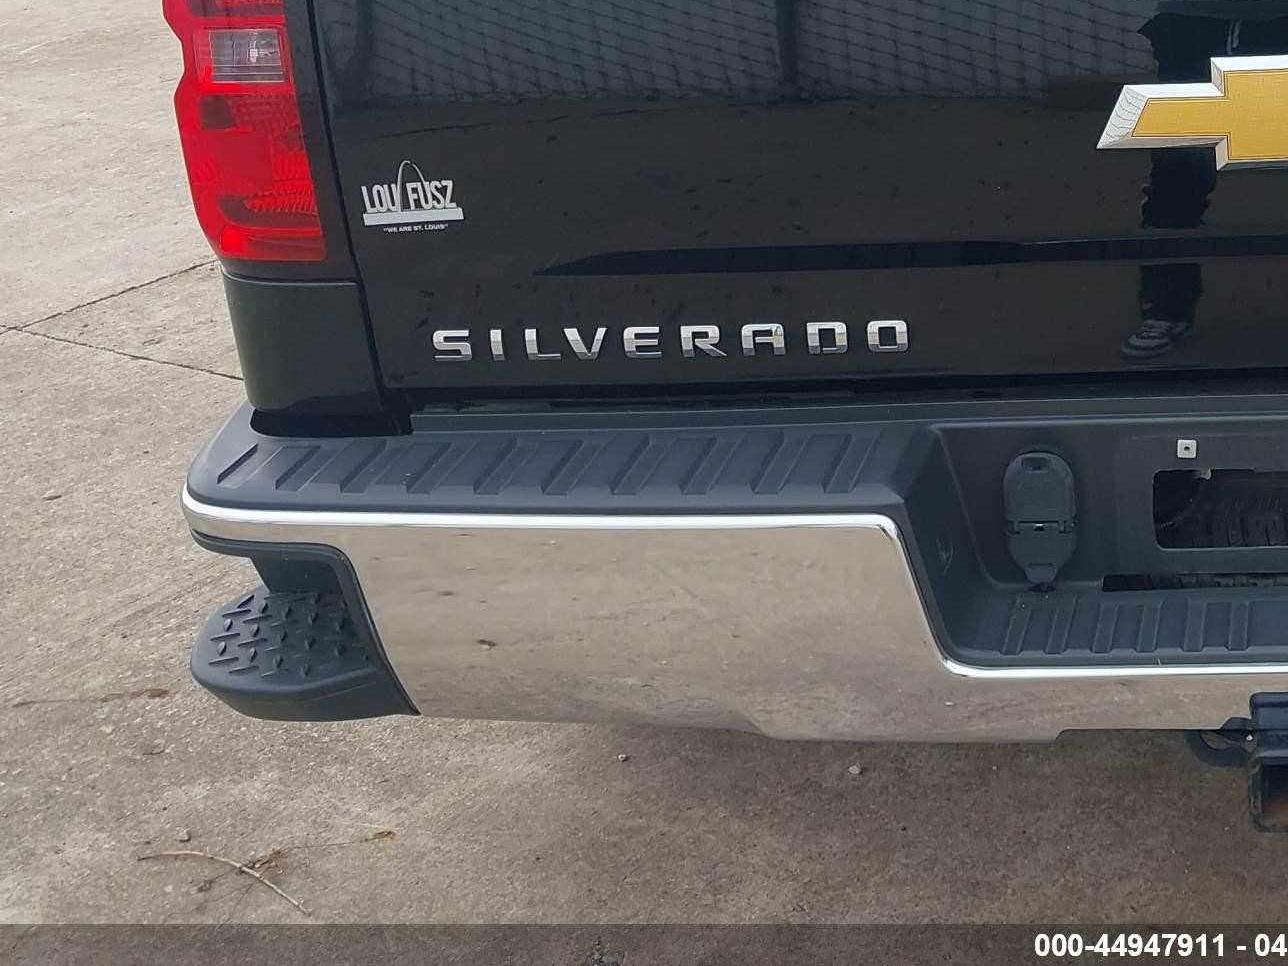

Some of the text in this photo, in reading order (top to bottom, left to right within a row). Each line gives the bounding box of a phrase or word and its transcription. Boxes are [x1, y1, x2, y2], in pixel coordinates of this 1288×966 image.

[361, 180, 457, 213] LOU FUSZ
[432, 319, 909, 362] SILVERADO
